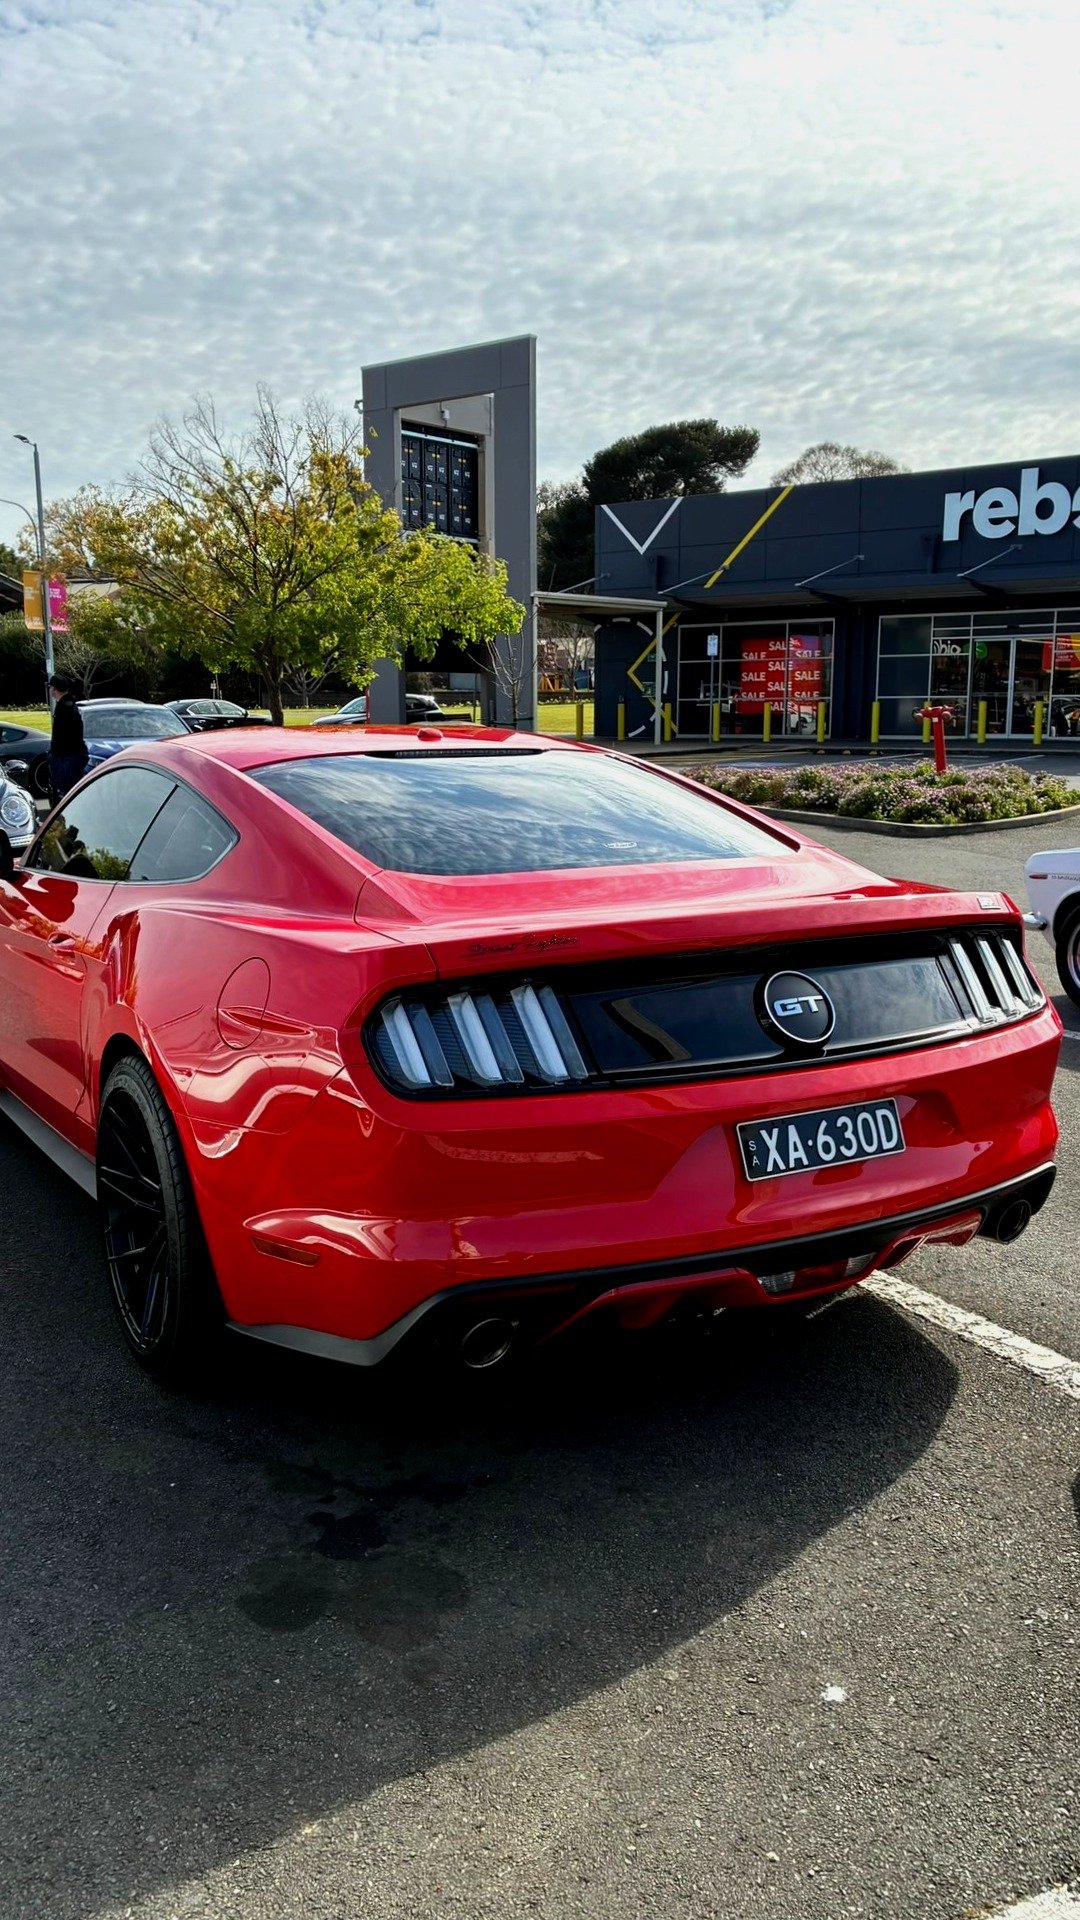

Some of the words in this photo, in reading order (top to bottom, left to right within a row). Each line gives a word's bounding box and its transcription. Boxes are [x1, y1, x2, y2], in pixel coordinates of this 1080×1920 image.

[943, 467, 1080, 542] reb
[769, 640, 794, 651] SALE
[742, 652, 767, 660] SALE
[796, 650, 821, 658] SALE
[768, 661, 793, 671] SALE
[741, 672, 766, 681] SALE
[794, 670, 821, 681] SALE
[767, 682, 793, 691] SALE
[741, 691, 766, 701] SALE
[794, 691, 821, 701] SALE
[774, 995, 823, 1016] GT
